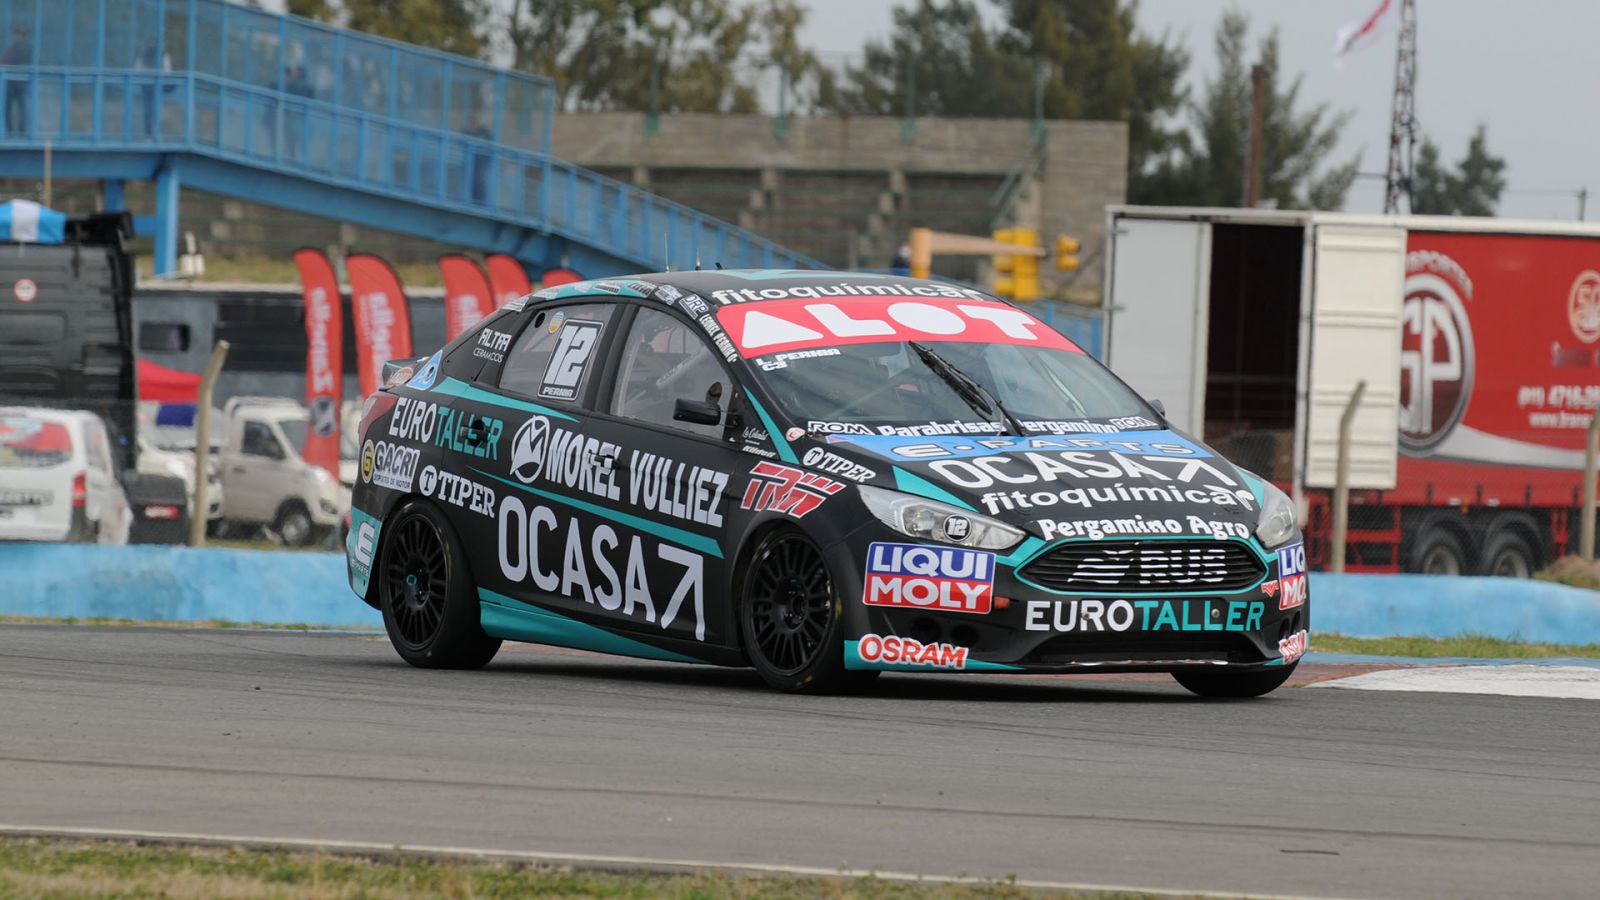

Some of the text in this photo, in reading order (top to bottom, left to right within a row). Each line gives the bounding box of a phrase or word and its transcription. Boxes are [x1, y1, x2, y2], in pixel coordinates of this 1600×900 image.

[685, 295, 709, 314] DRP
[543, 325, 599, 387] 12
[775, 348, 841, 362] PERNIA
[542, 387, 574, 398] PERNIA
[808, 421, 875, 436] ROM
[876, 420, 1007, 437] Parabrisas
[374, 440, 420, 478] GACRI
[817, 452, 876, 483] TIPER
[928, 451, 1174, 489] OCASA
[438, 470, 495, 518] TIPER
[545, 428, 730, 528] MOREL VULLIEZ
[740, 460, 847, 519] TRW
[948, 518, 967, 536] 12
[1037, 514, 1250, 541] Pergamino Agro
[498, 495, 657, 623] OCASA
[872, 546, 988, 580] LIQUI
[870, 576, 989, 609] MOLY
[1025, 600, 1265, 632] EUROTALLER
[859, 633, 969, 669] OSRAM
